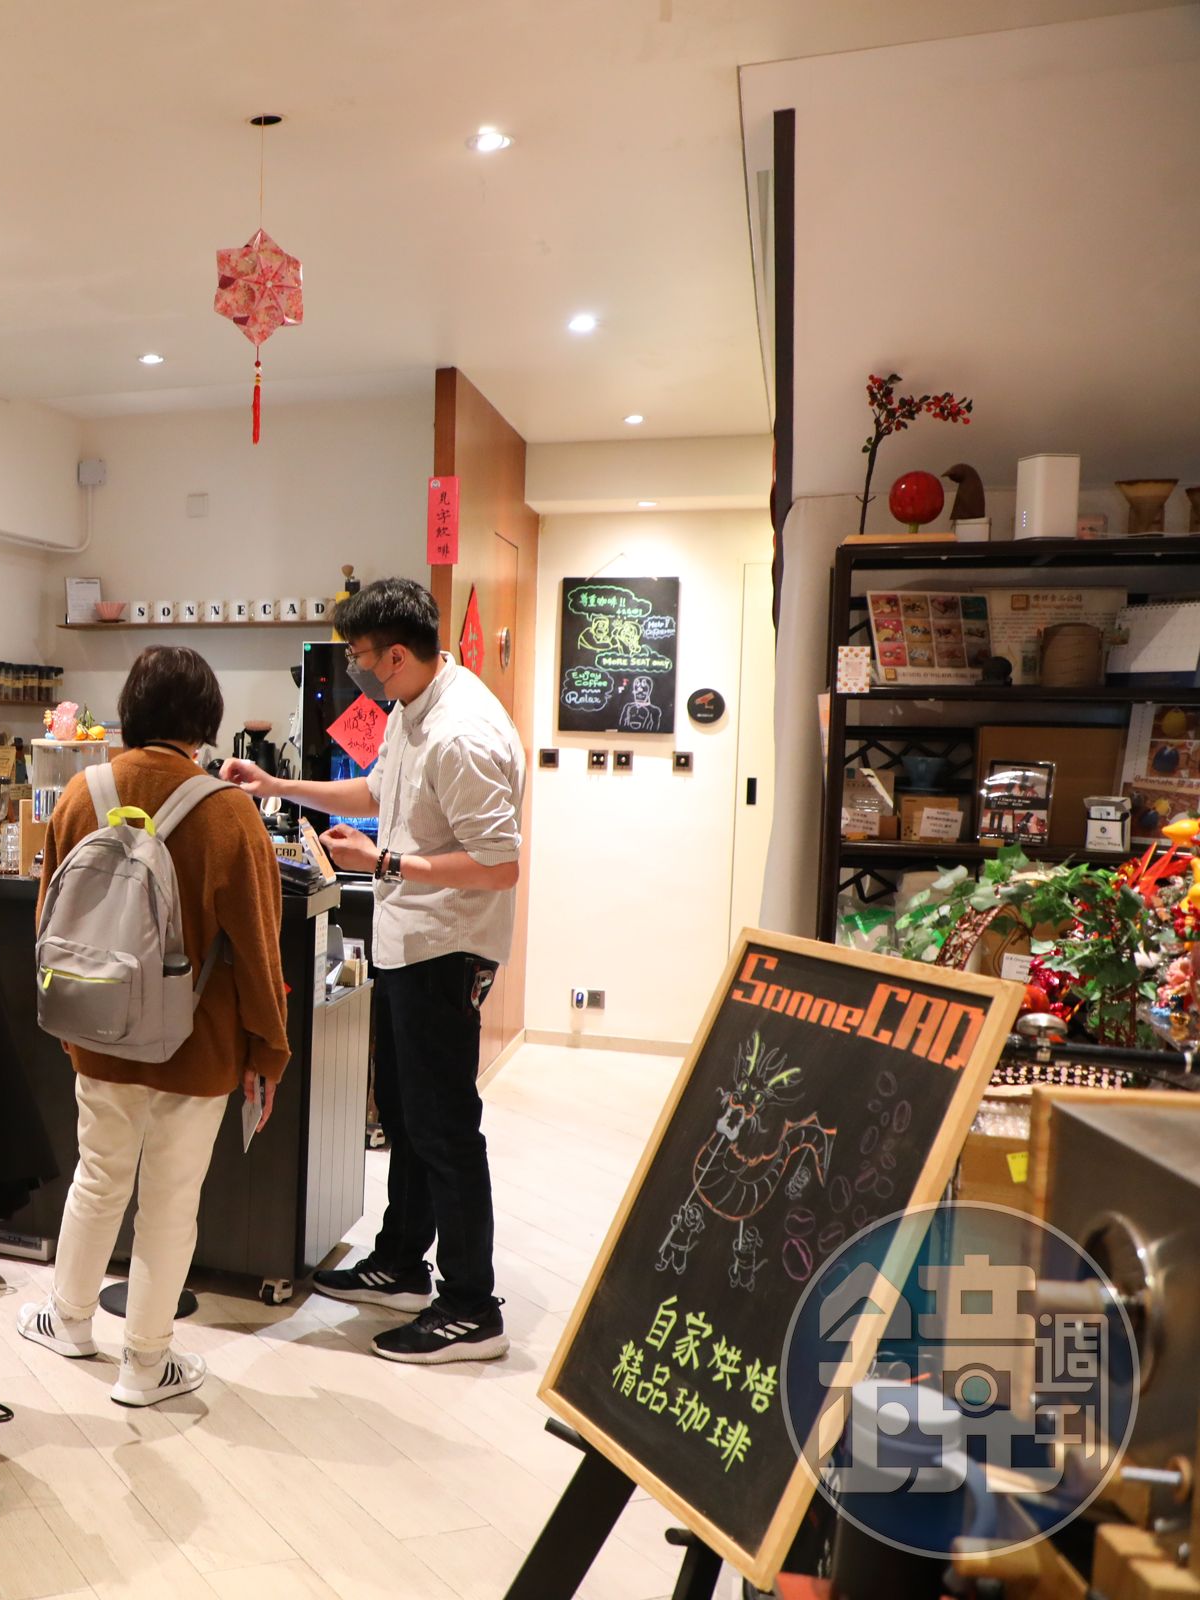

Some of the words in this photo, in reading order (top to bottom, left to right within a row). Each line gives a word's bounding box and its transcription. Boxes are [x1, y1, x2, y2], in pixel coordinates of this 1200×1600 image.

[731, 952, 986, 1071] SonneCAD
[645, 1295, 778, 1414] 自家烘焙
